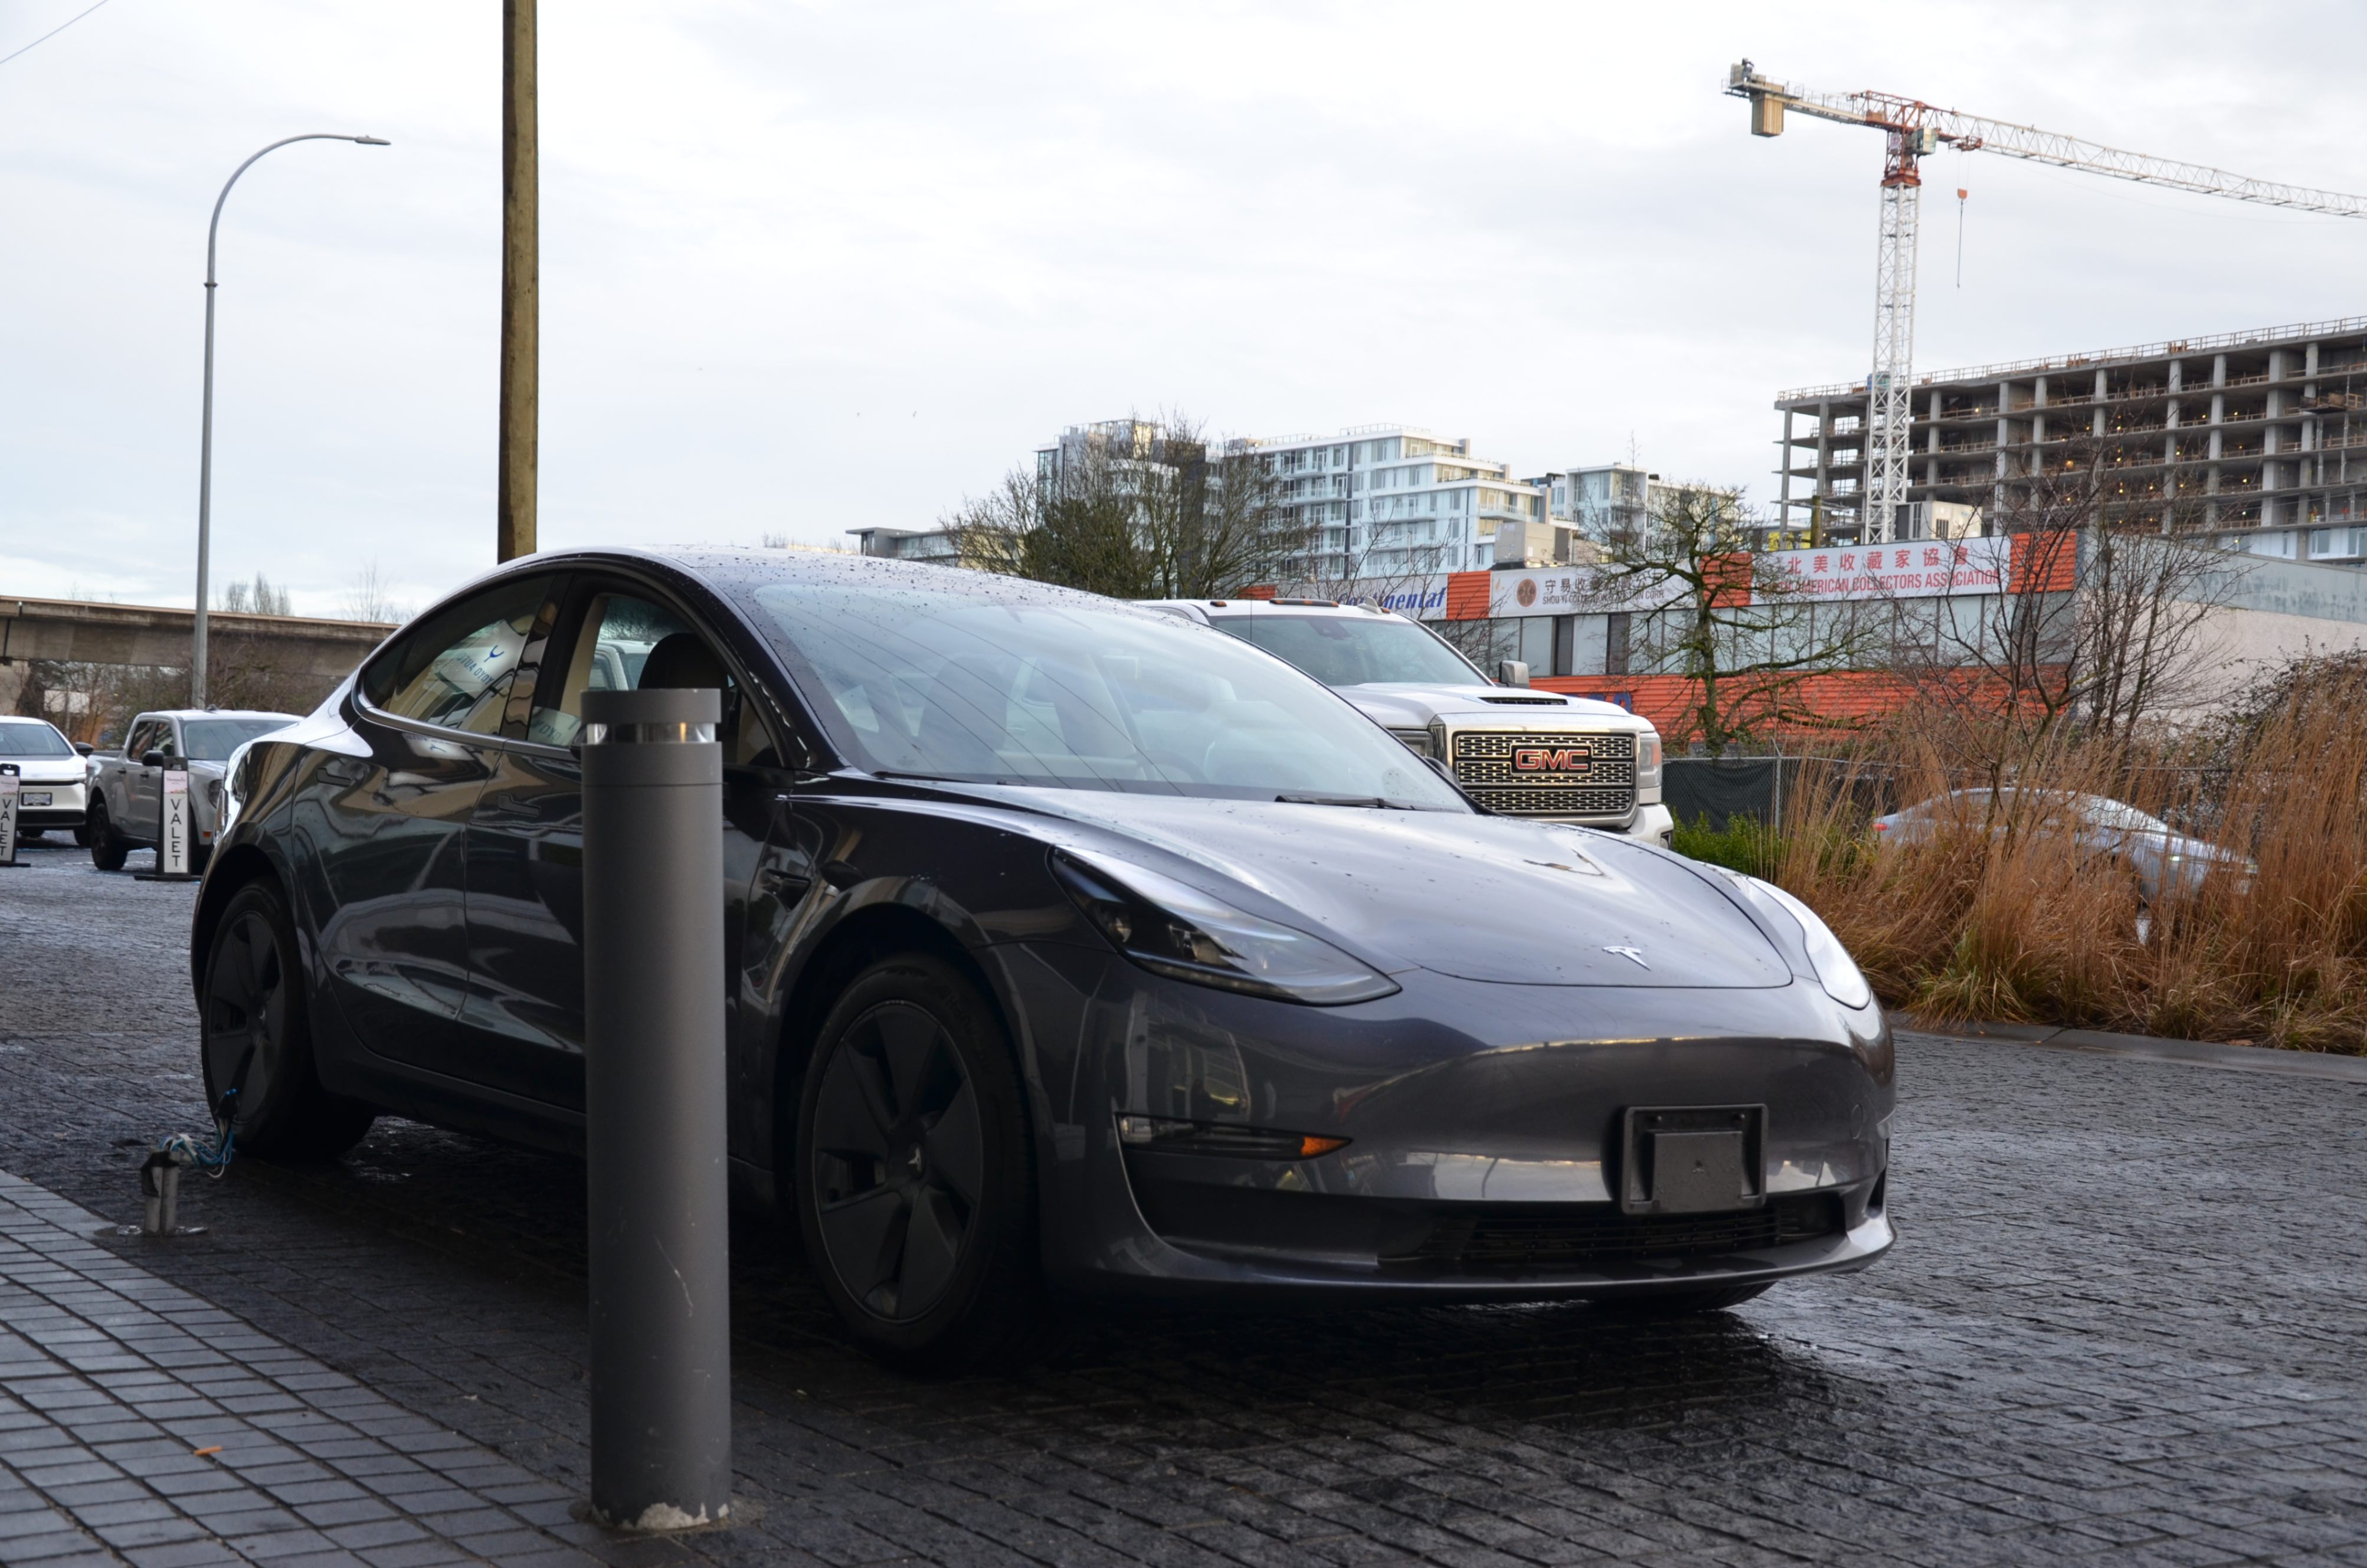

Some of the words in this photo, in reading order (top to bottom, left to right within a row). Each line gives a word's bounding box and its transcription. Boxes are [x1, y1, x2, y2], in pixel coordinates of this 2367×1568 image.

[1852, 574, 1921, 592] COLLECTORS
[1925, 569, 2001, 588] ASSOCIATION
[1337, 587, 1446, 610] Conental
[1543, 594, 1560, 605] SHOU
[1516, 749, 1589, 770] GMC
[0, 798, 12, 856] VALET
[170, 798, 182, 868] VALET
